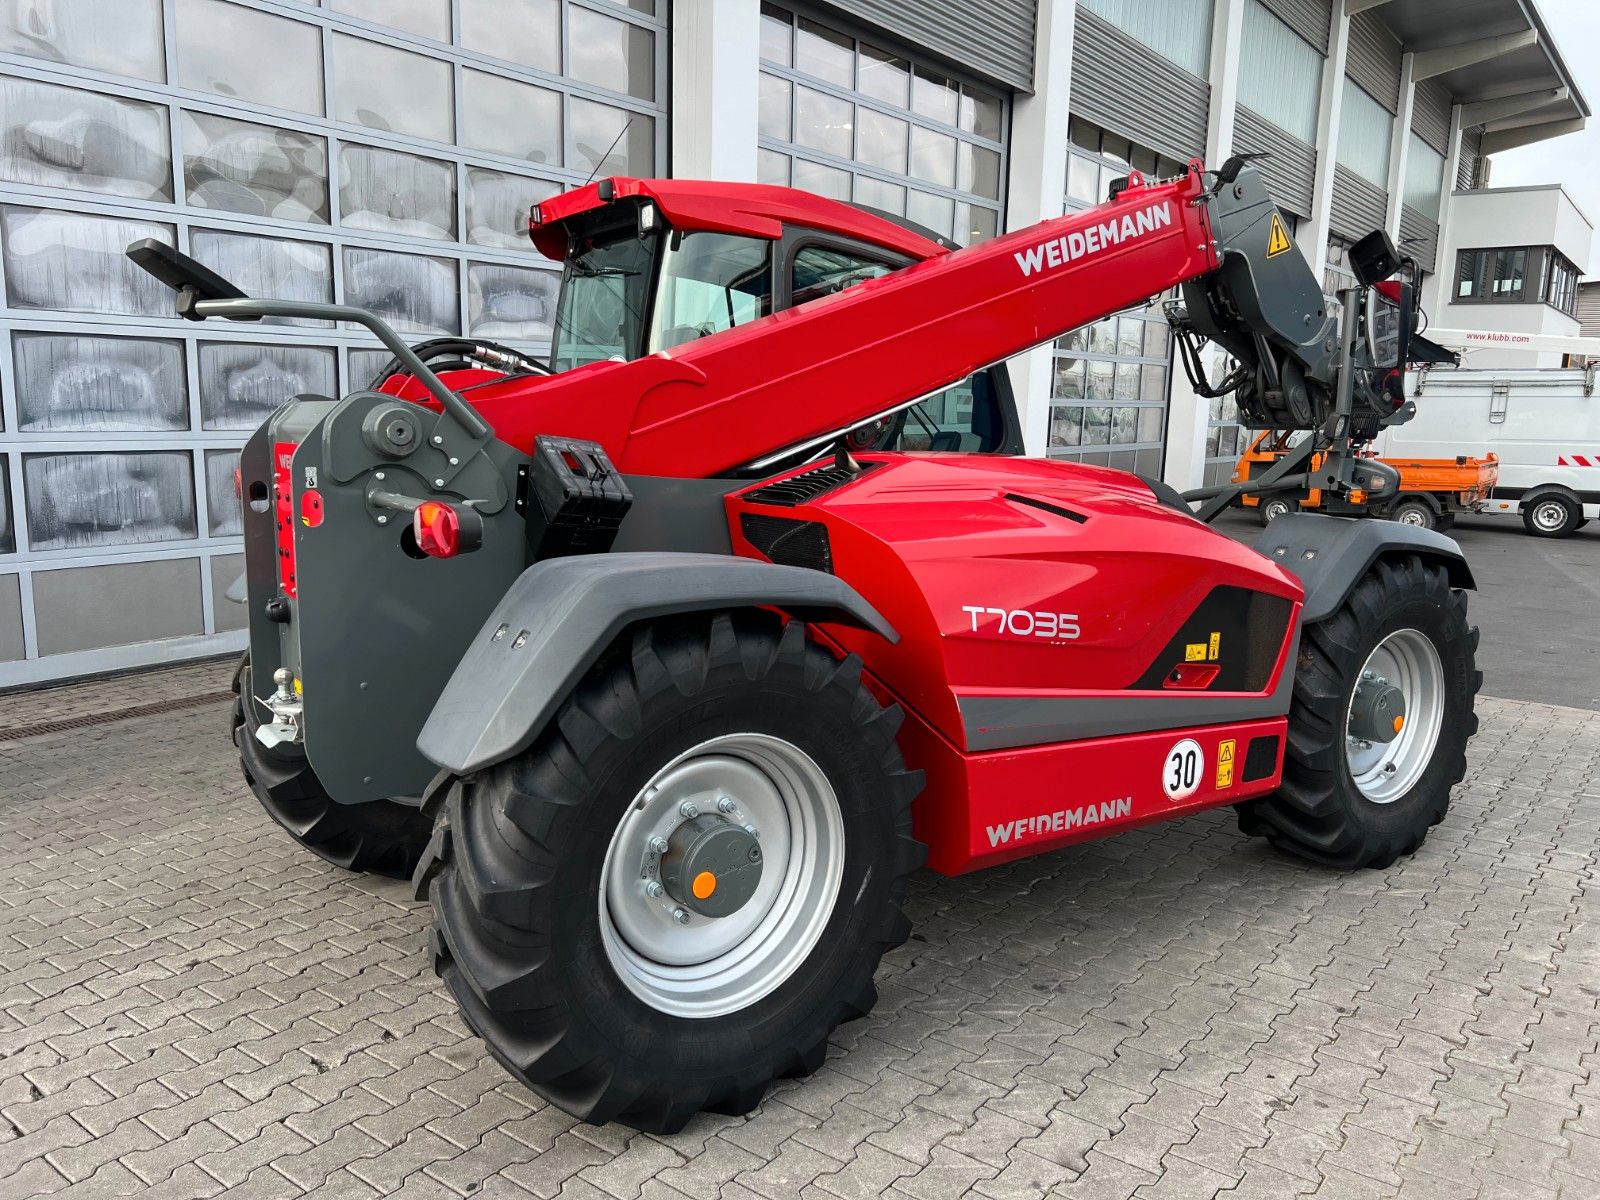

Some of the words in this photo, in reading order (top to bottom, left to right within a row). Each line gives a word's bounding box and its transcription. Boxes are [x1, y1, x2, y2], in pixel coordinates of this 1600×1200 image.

[1013, 201, 1172, 277] WEIDEMANN
[1466, 333, 1530, 343] www.klubb.com
[962, 605, 1081, 639] T7035
[1169, 749, 1197, 792] 30
[985, 796, 1132, 848] WEIDEMANN
